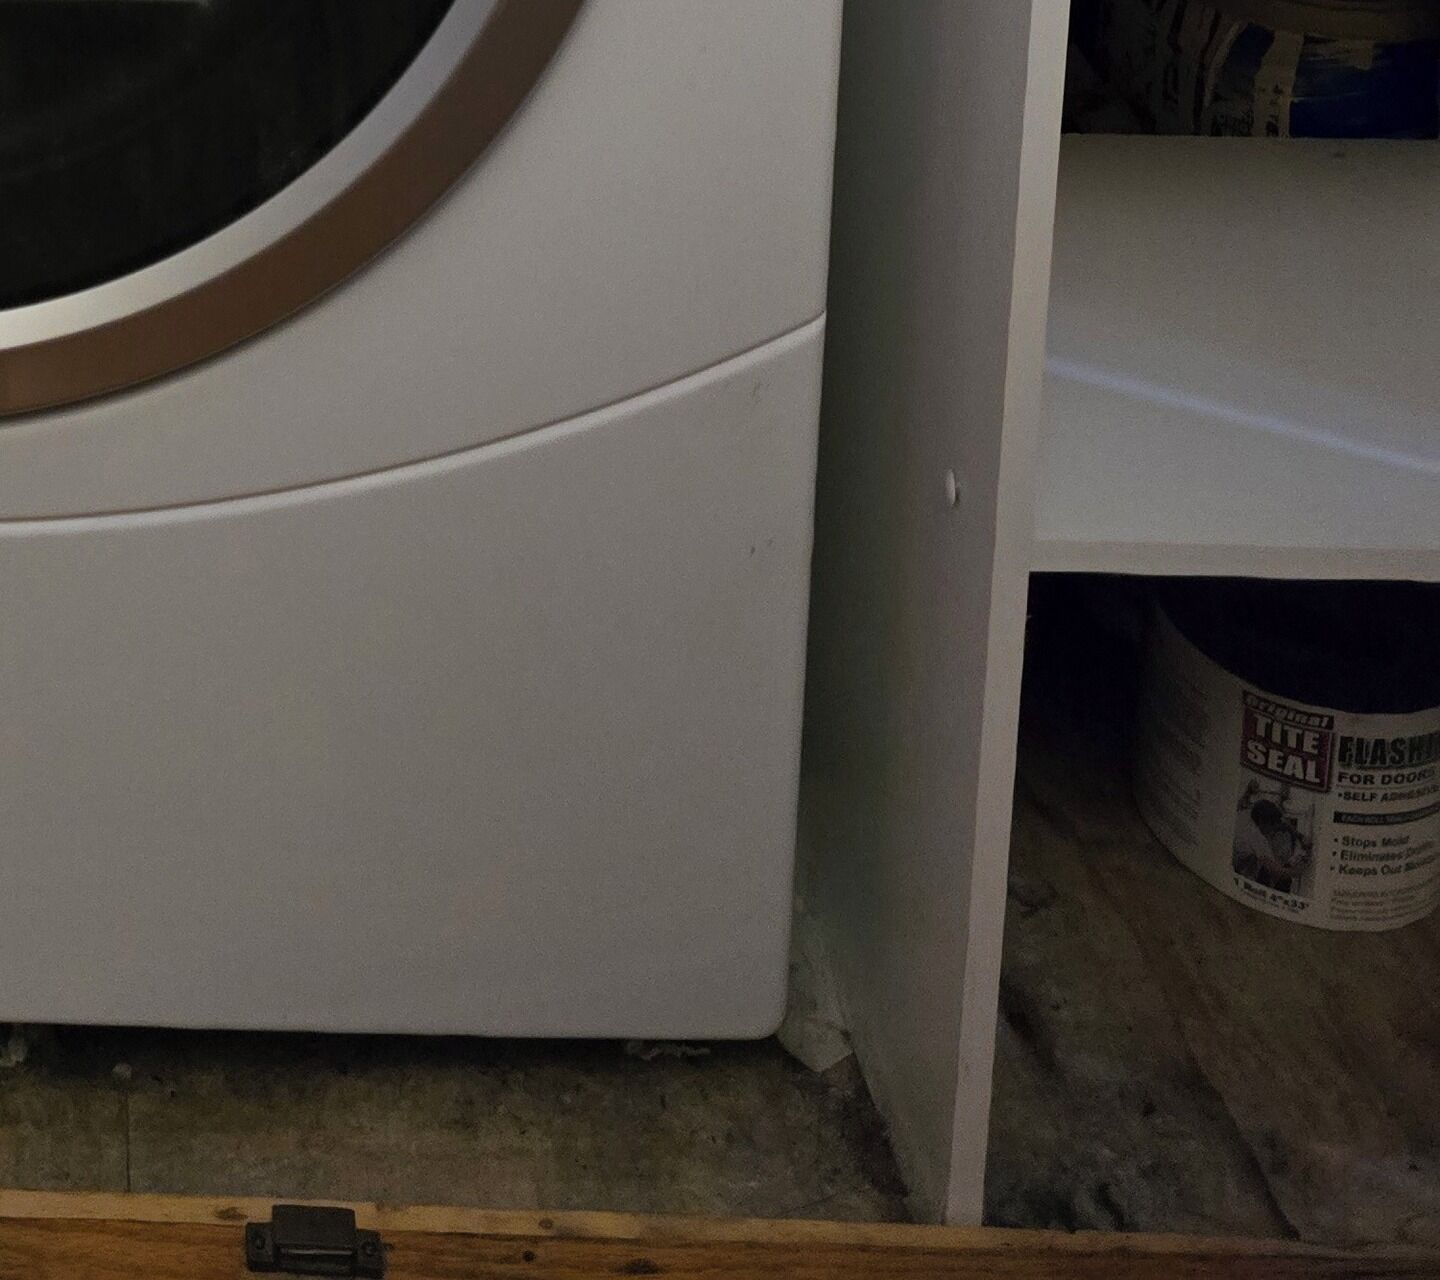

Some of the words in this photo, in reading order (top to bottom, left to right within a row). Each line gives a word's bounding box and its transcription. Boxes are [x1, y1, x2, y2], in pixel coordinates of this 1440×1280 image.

[1253, 713, 1321, 754] TITE
[1247, 738, 1321, 784] SEAL
[1337, 771, 1376, 786] FOR
[1341, 835, 1377, 849] Stops
[1337, 863, 1378, 877] Keeps
